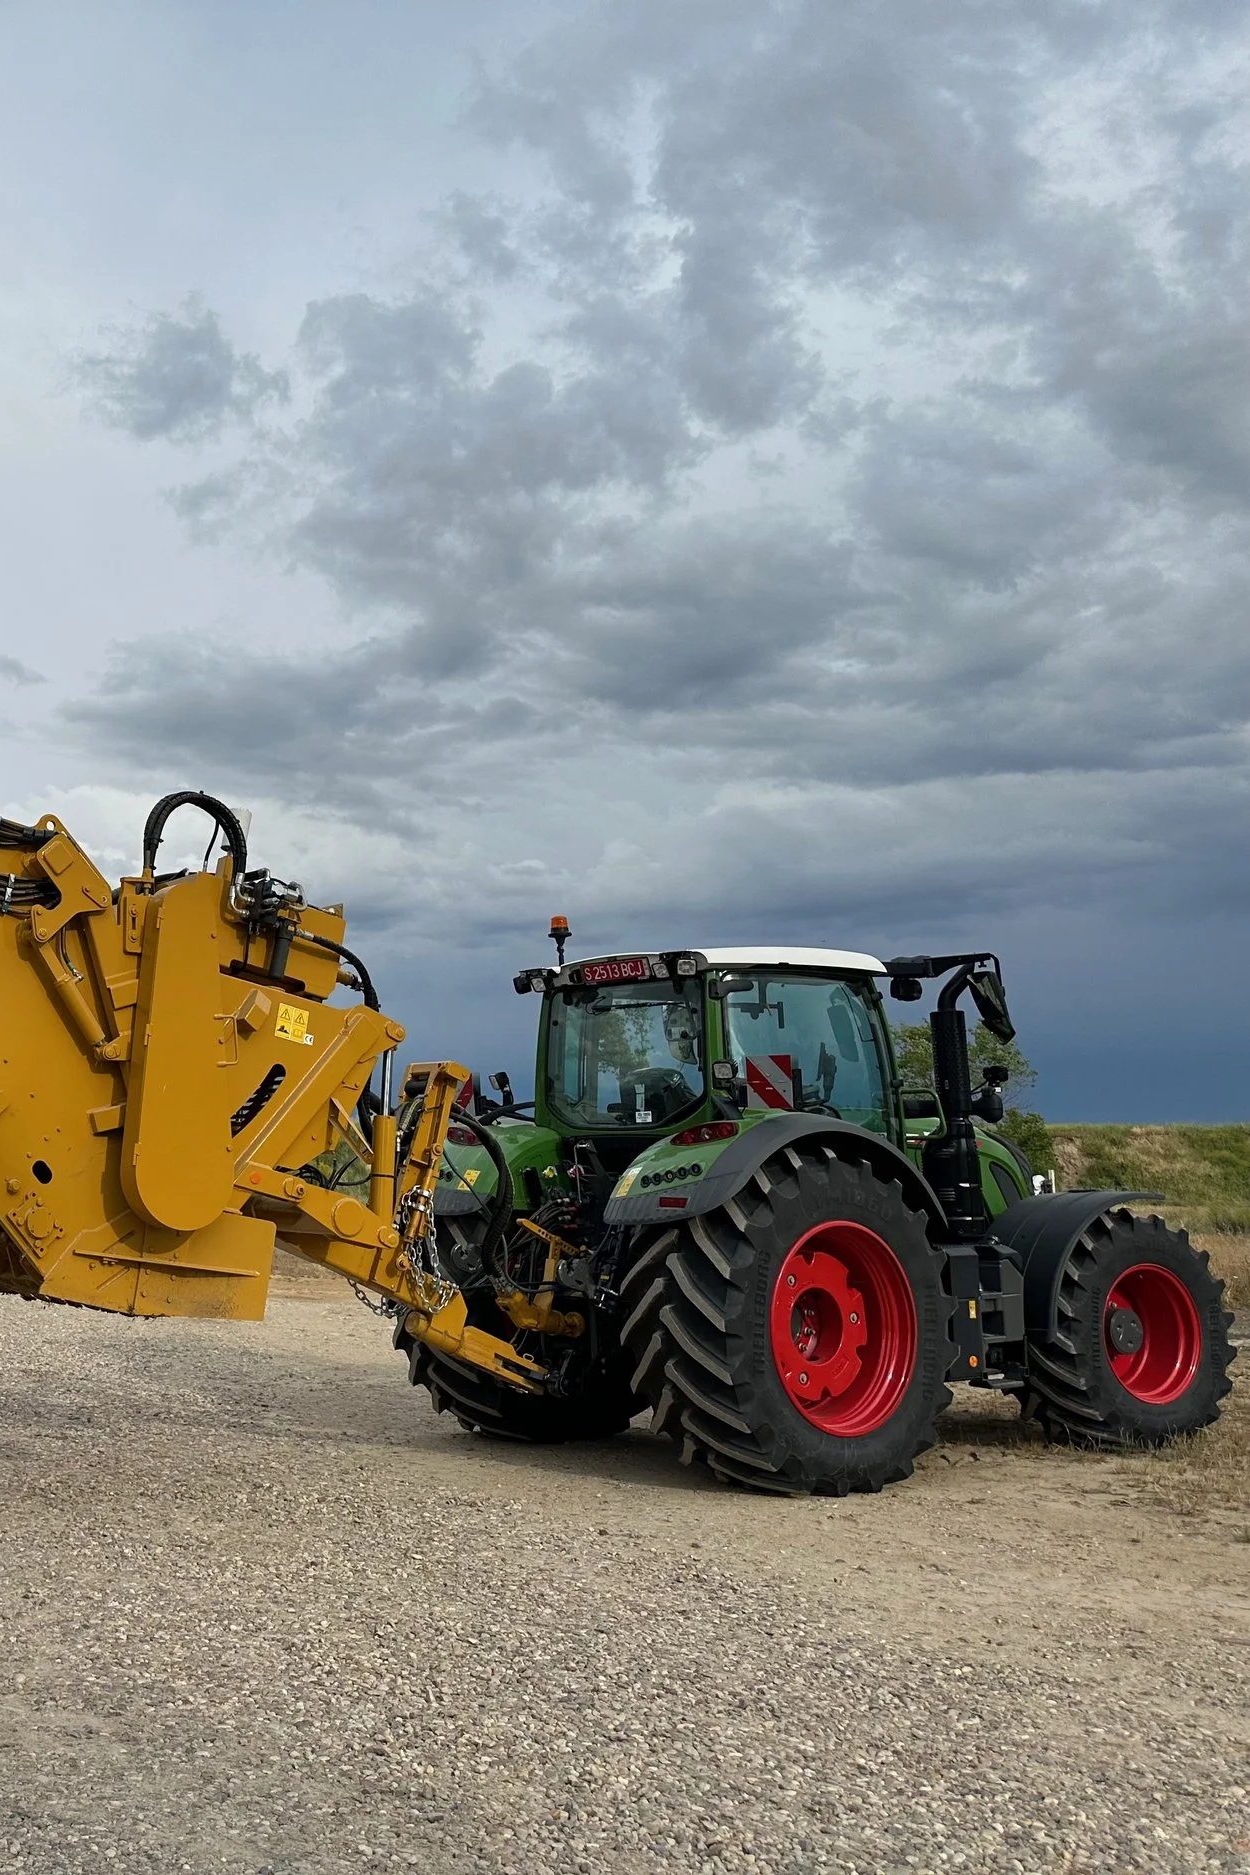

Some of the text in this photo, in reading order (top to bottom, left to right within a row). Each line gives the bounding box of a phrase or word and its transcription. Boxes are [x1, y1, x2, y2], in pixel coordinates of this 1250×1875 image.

[584, 961, 642, 981] S 2513 BCJ
[751, 1250, 771, 1378] TRELLEBORG
